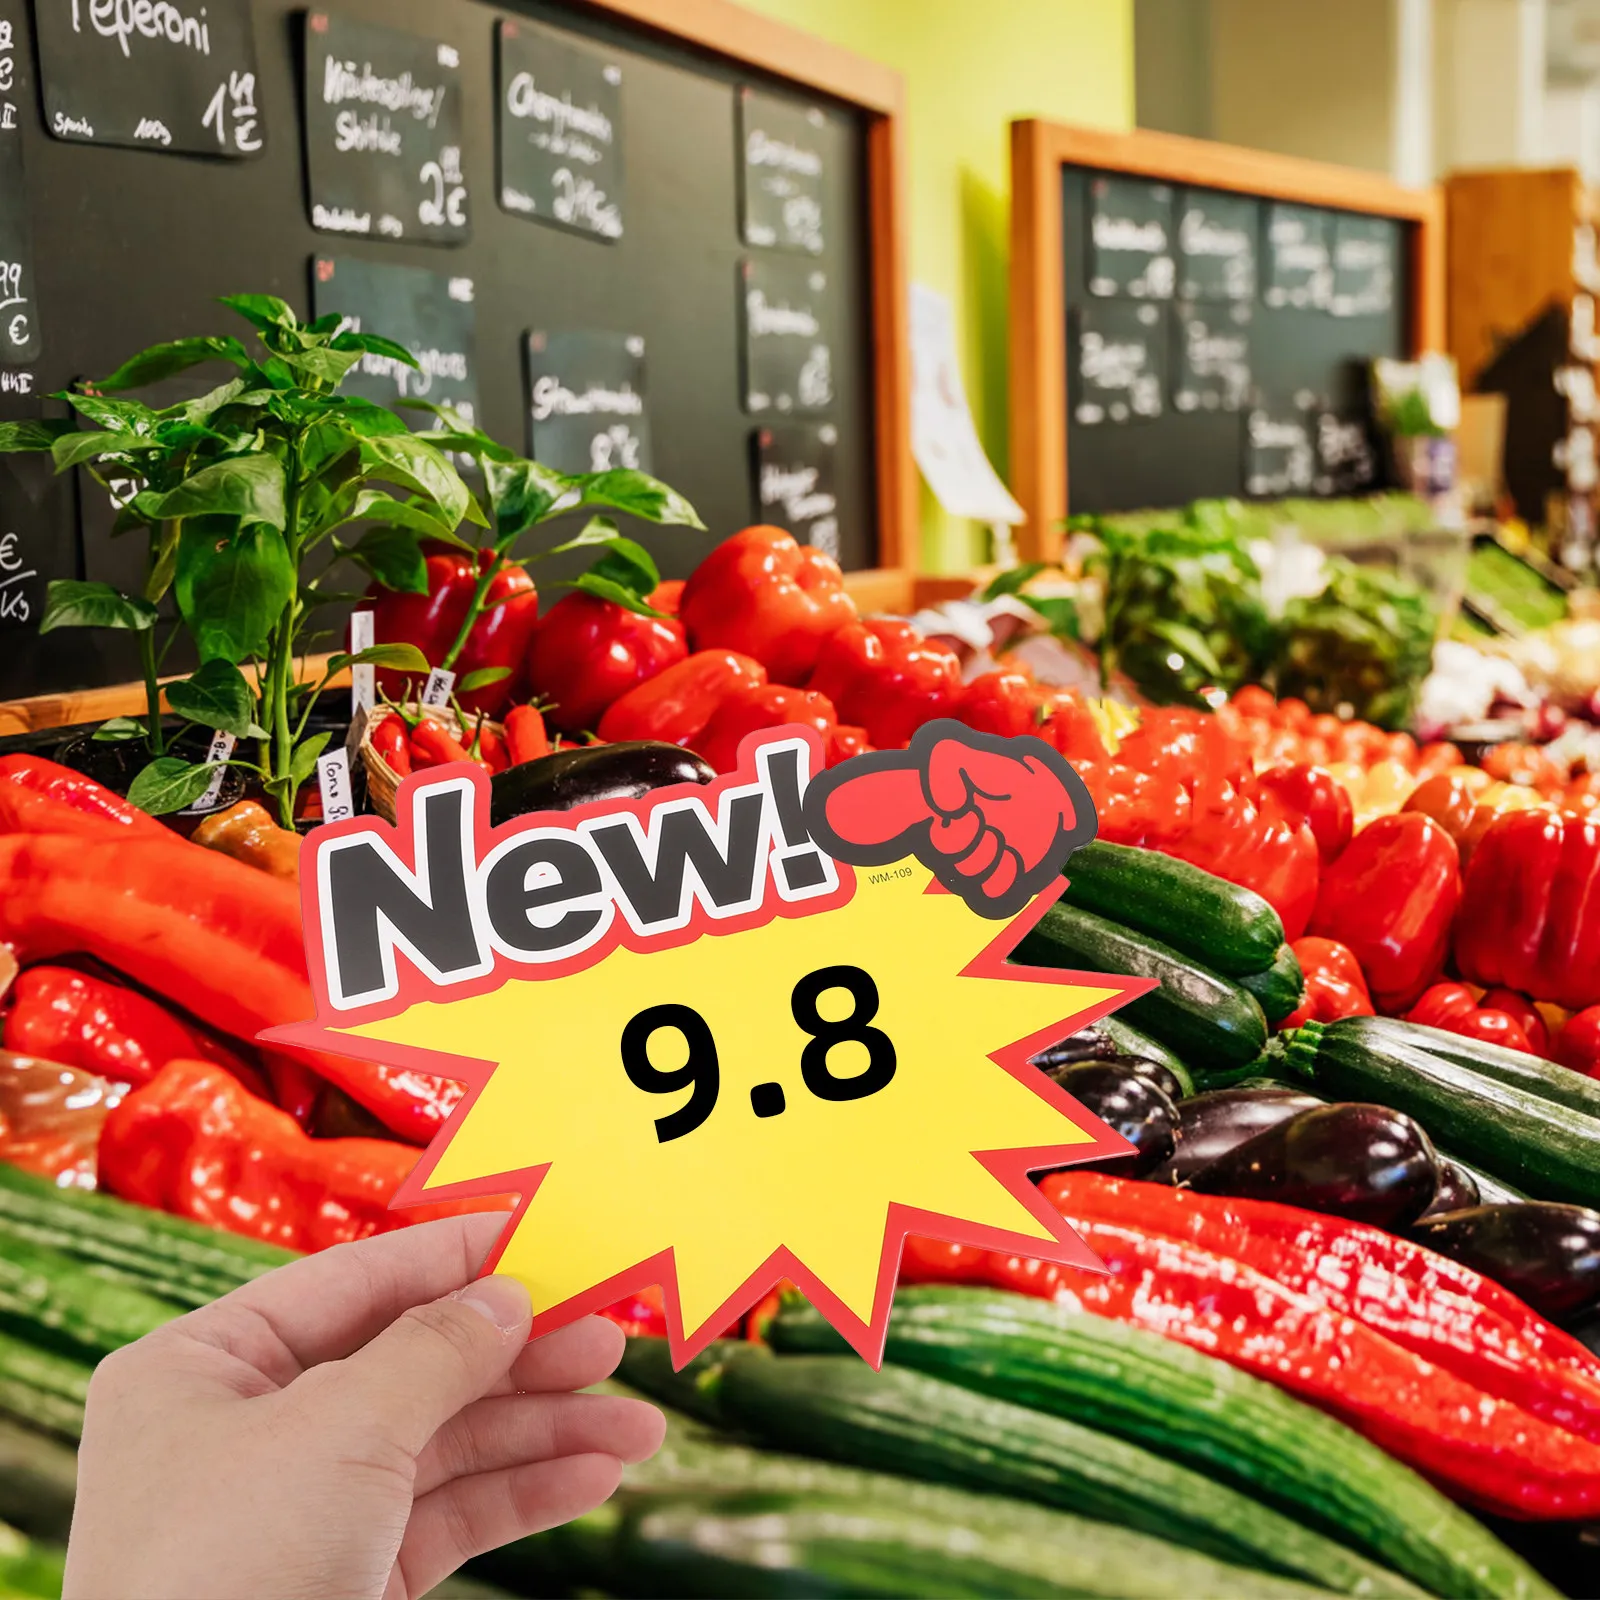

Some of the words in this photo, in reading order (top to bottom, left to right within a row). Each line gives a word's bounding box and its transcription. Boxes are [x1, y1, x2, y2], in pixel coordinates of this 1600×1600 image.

[9, 314, 30, 346] €
[328, 747, 830, 999] New!
[867, 867, 913, 885] WM-109
[620, 964, 897, 1144] 9.8
